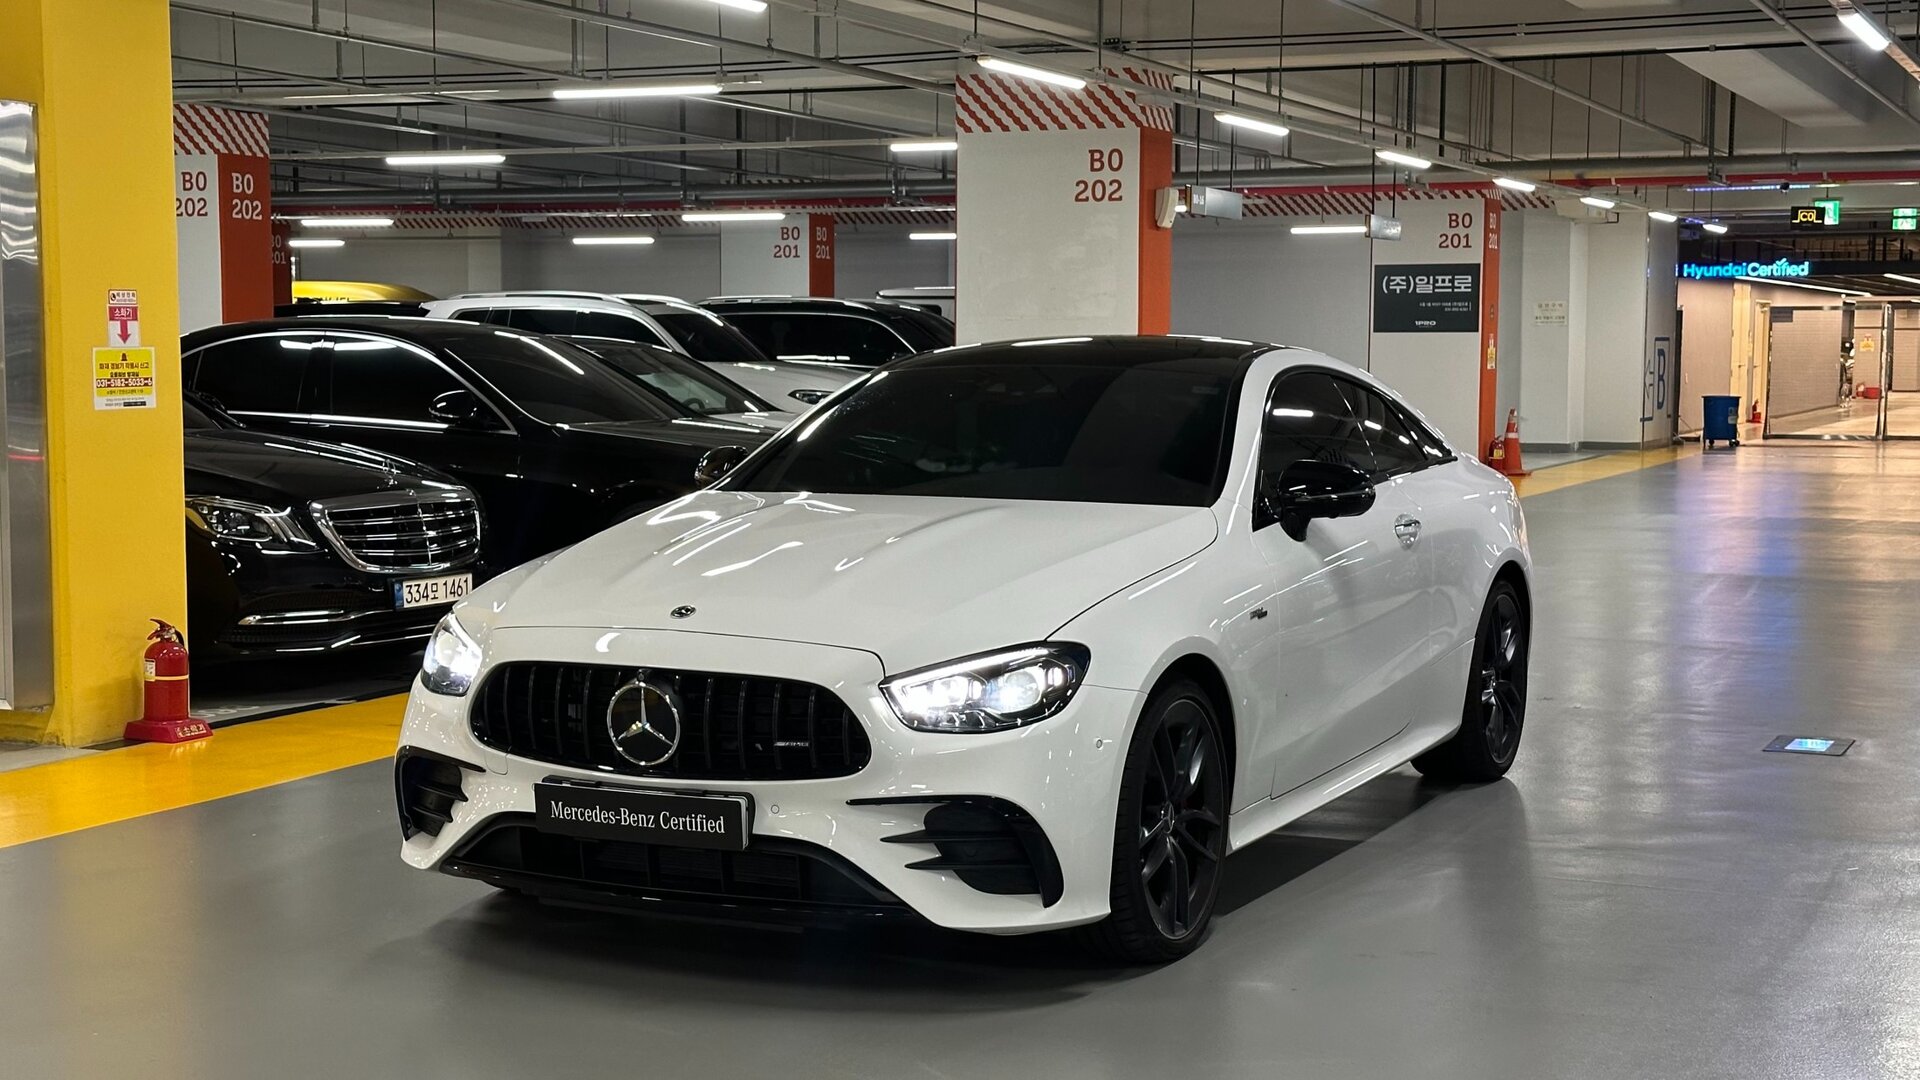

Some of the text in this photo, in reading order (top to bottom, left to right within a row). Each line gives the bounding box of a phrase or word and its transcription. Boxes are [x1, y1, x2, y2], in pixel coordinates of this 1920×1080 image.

[1074, 179, 1123, 203] 202
[232, 199, 263, 220] 202
[773, 245, 800, 258] 201
[1438, 233, 1472, 249] 201
[815, 245, 831, 260] 201
[1683, 258, 1810, 280] Hyundai Certified
[1382, 275, 1472, 294] (주)일프로
[114, 308, 132, 317] 소화기
[1657, 348, 1666, 410] B
[405, 577, 469, 604] 334모 1461
[550, 800, 726, 834] Mercedes-Benz Certified
